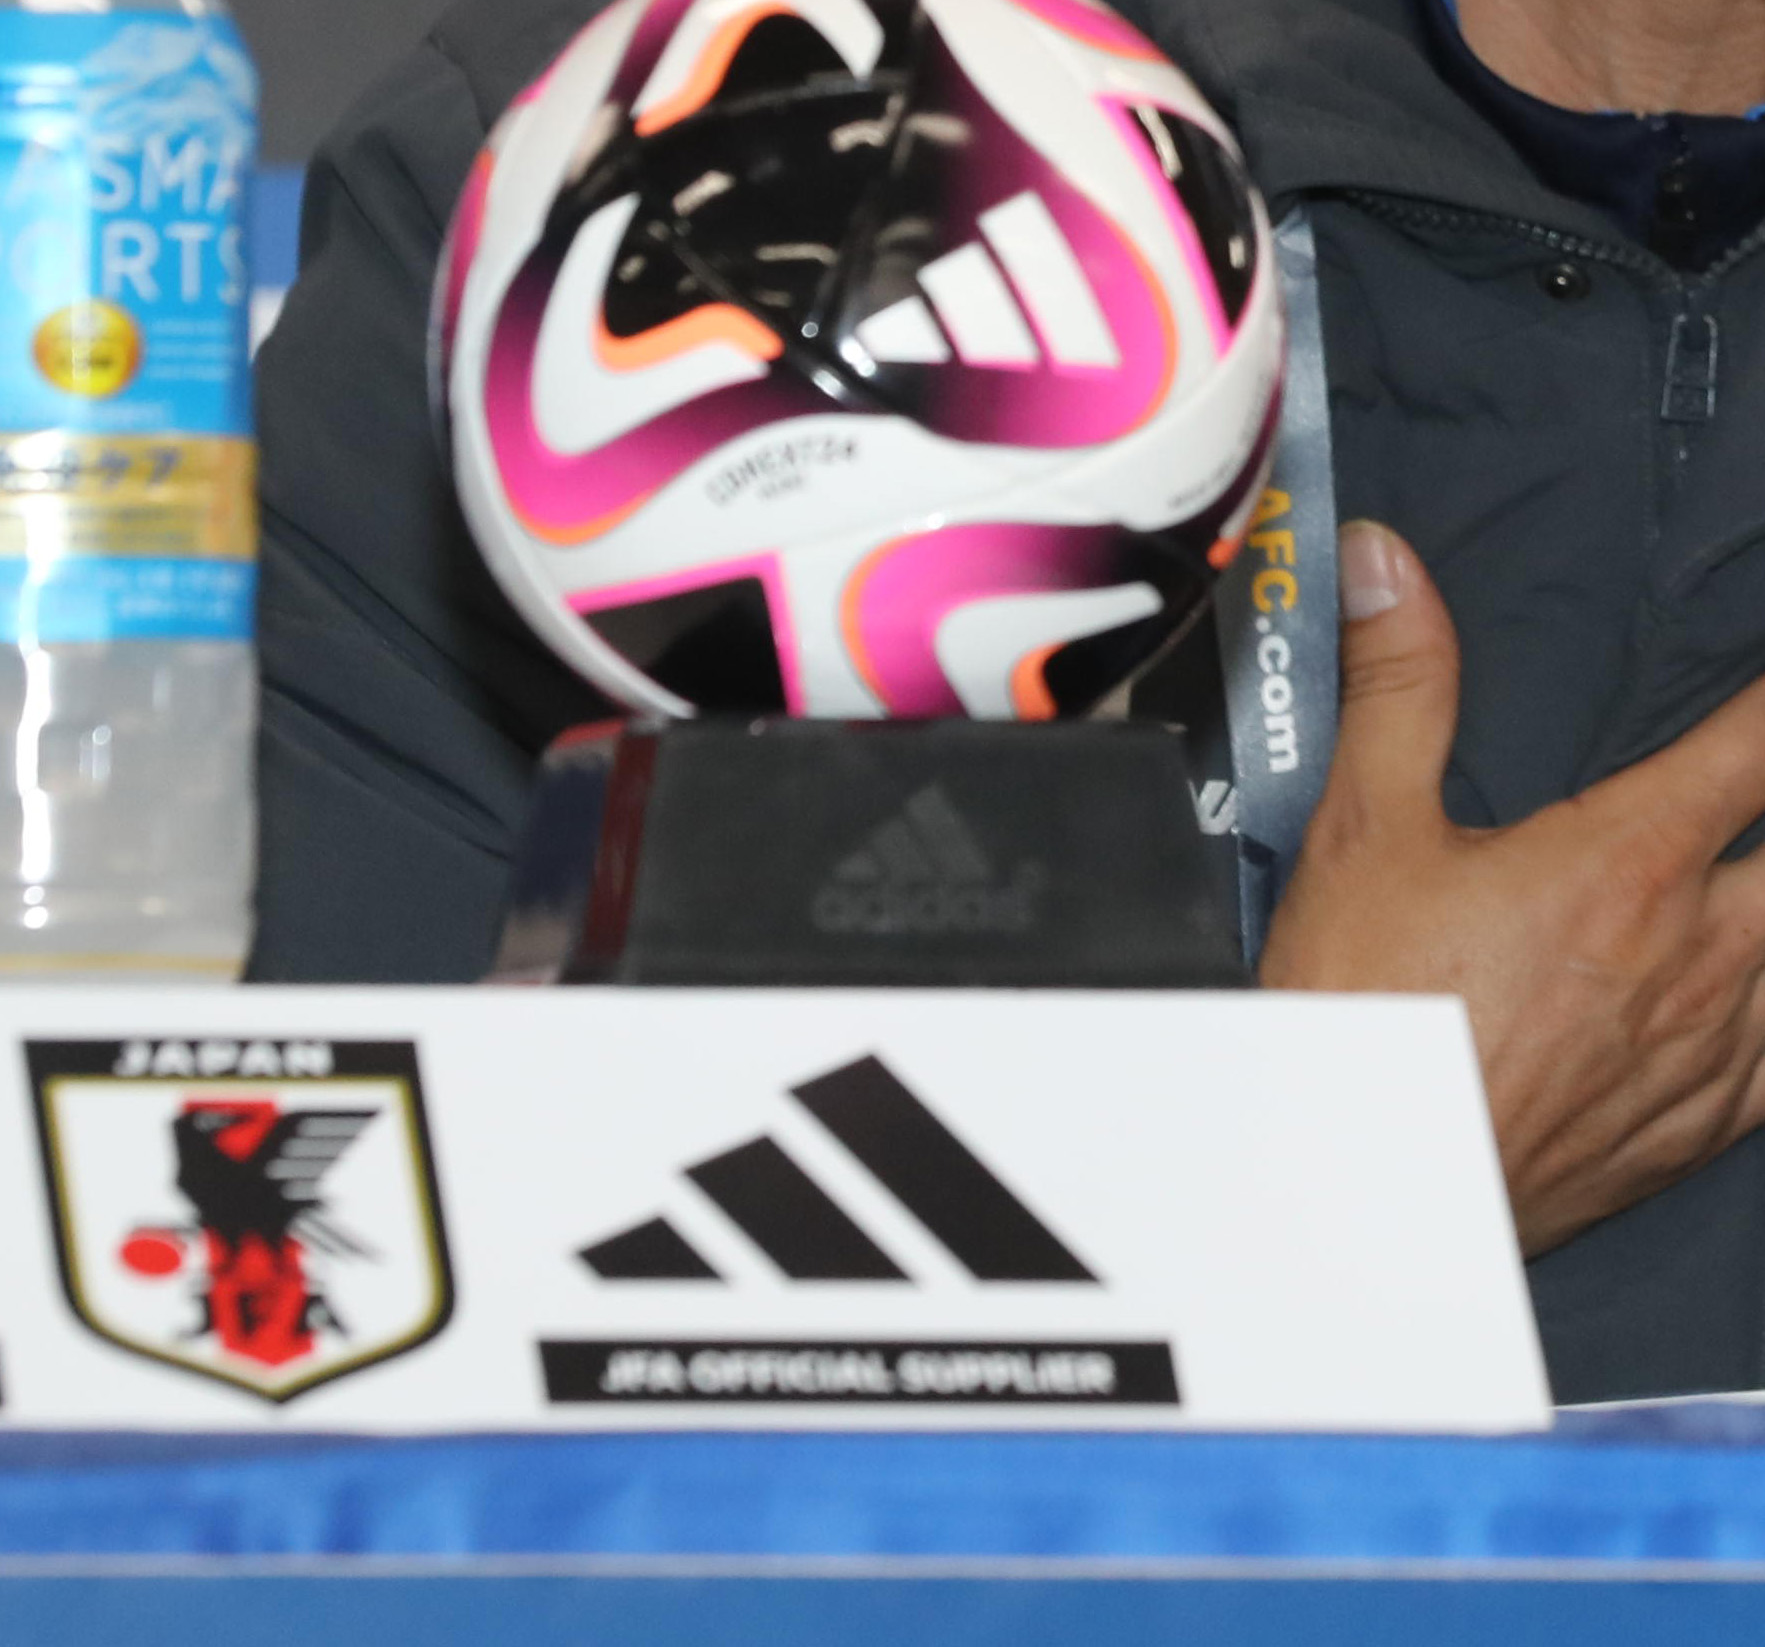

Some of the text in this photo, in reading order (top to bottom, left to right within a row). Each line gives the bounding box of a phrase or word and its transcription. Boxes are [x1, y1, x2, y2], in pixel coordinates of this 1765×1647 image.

[113, 1040, 334, 1077] JAPAN
[602, 1350, 1116, 1395] JFA OFFICIAL SUPPLIER
